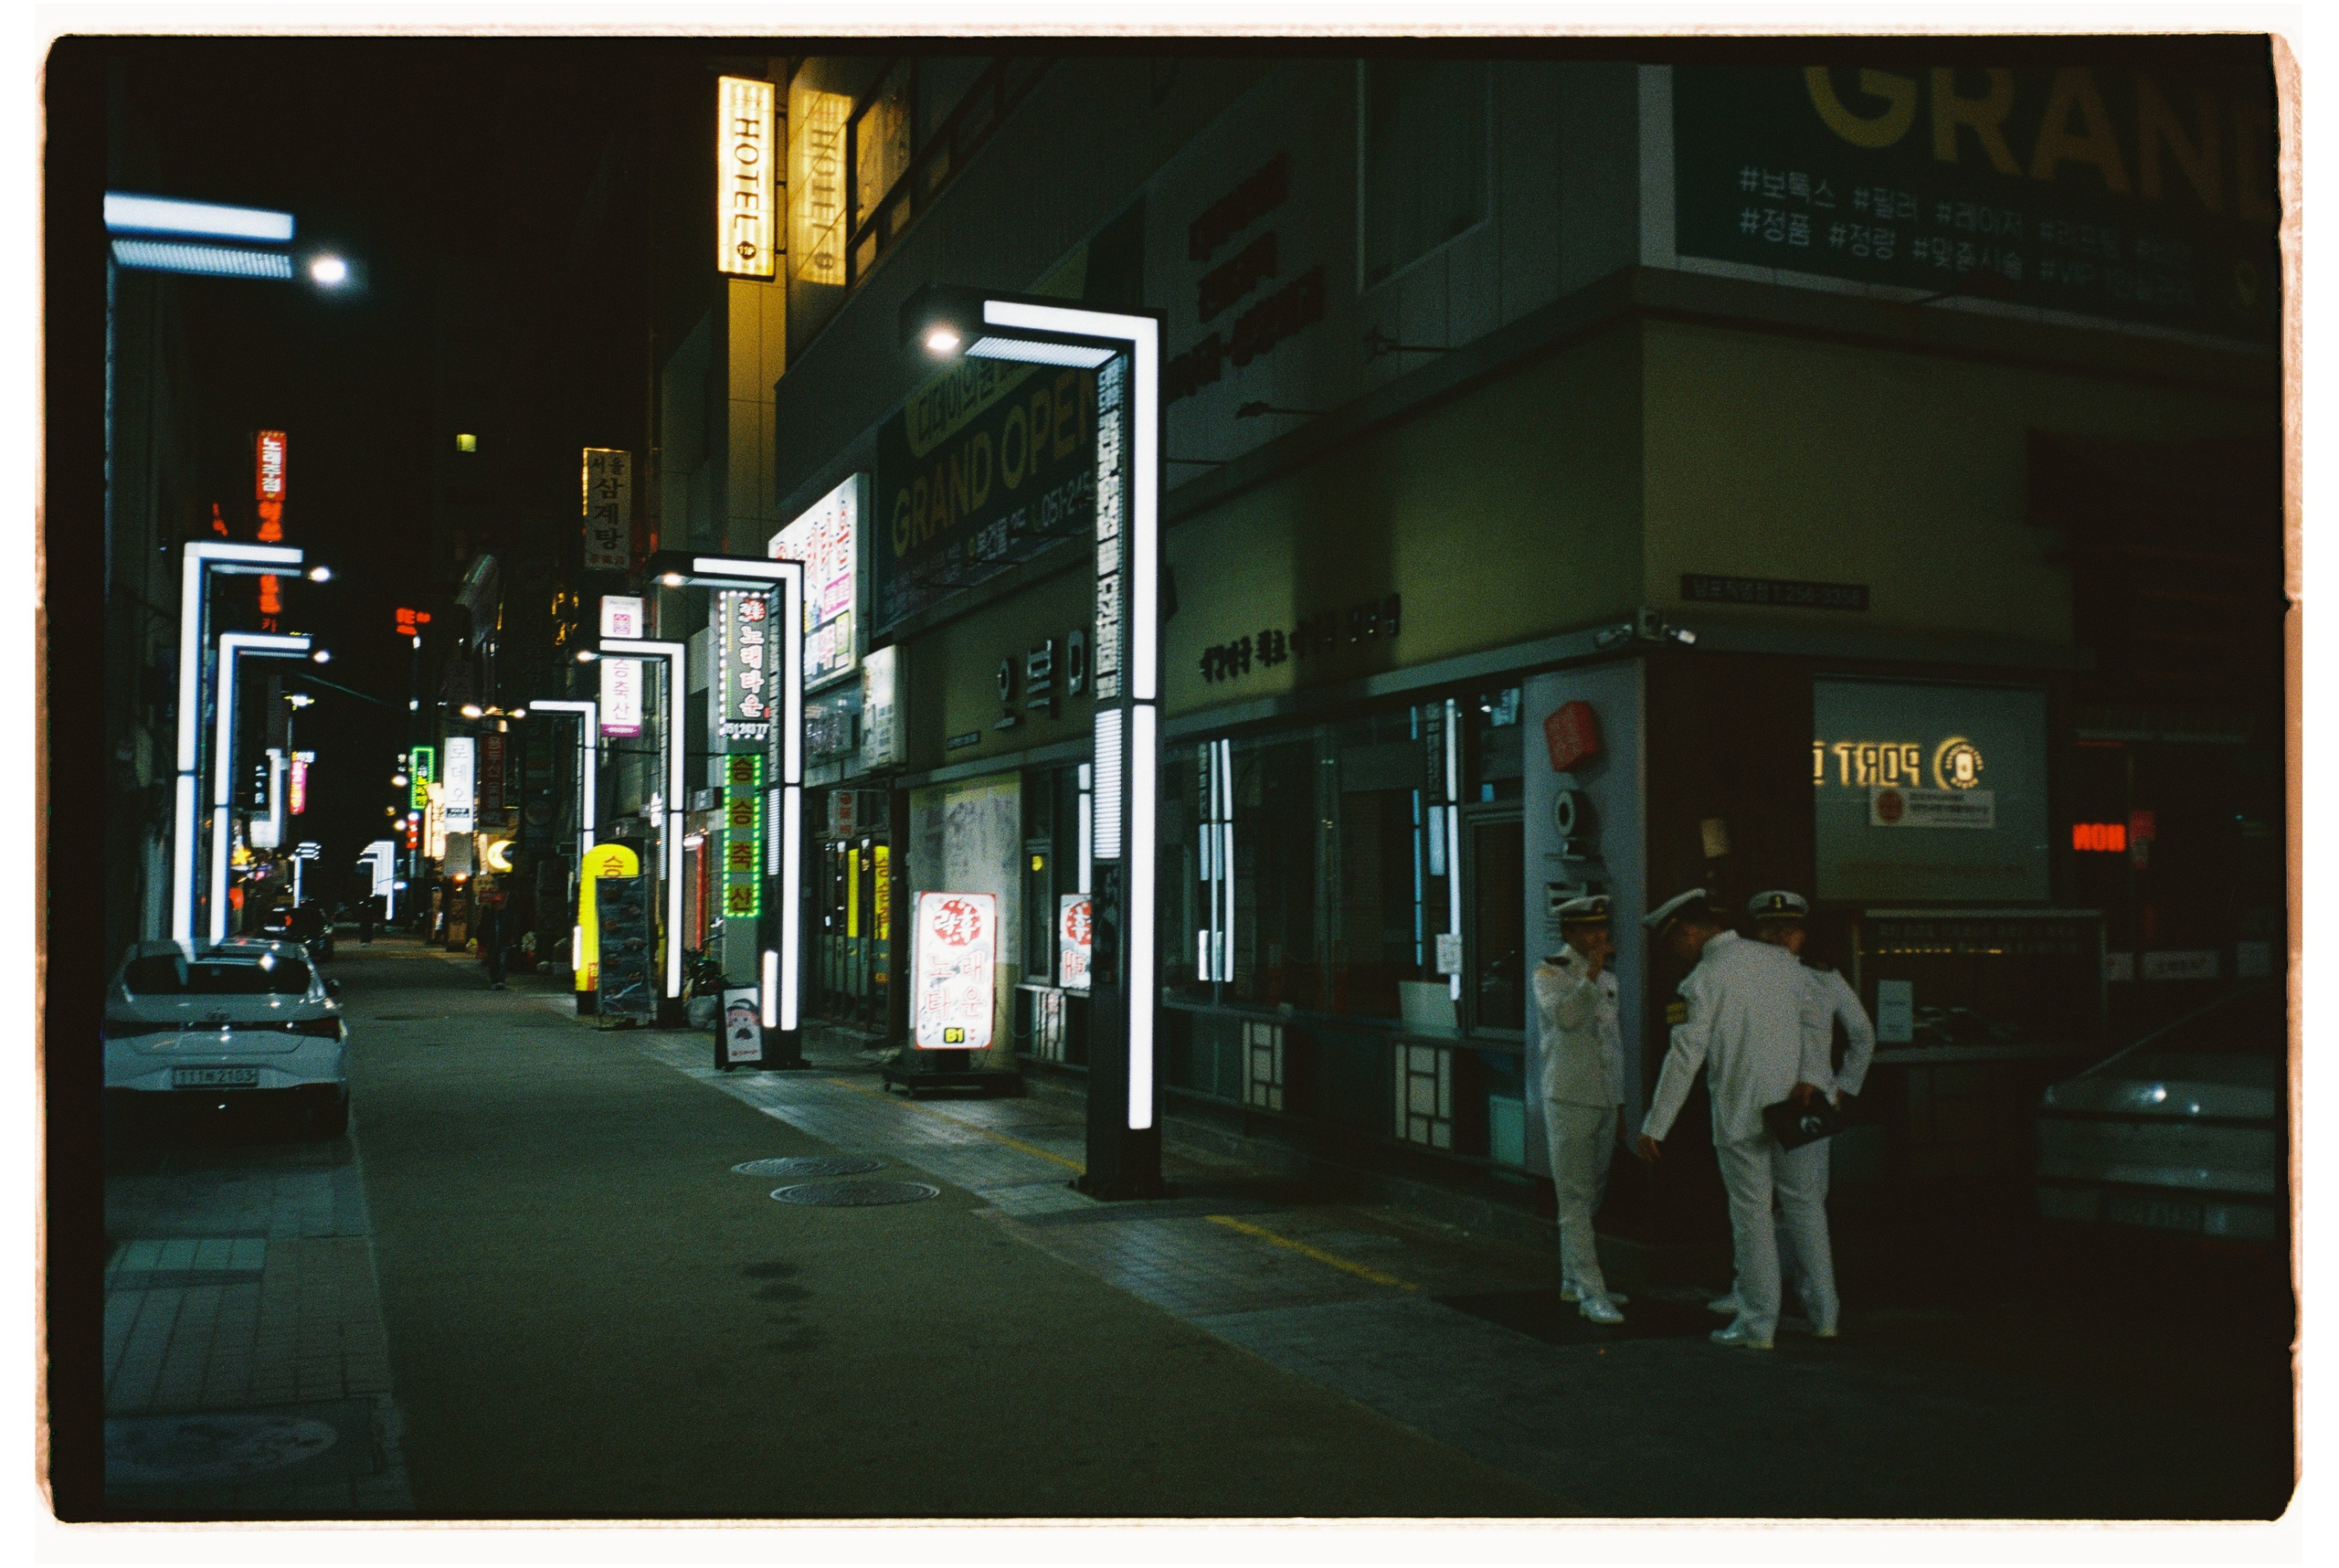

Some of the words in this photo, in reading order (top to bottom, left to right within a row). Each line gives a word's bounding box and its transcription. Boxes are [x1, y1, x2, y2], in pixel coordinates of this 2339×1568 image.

[736, 118, 759, 228] HOTEL
[1739, 165, 1836, 210] #보톡스
[1851, 185, 1920, 223] #필러
[1934, 200, 2024, 240] #레이저
[1739, 206, 1812, 248] #정품
[590, 457, 625, 475] 서울
[892, 431, 992, 557] GRAND
[593, 478, 624, 550] 삼계탕
[738, 625, 765, 718] 노래타운
[732, 758, 753, 912] 승승축산
[929, 950, 984, 982] 노래
[927, 987, 986, 1020] 타운
[945, 1029, 965, 1043] B1
